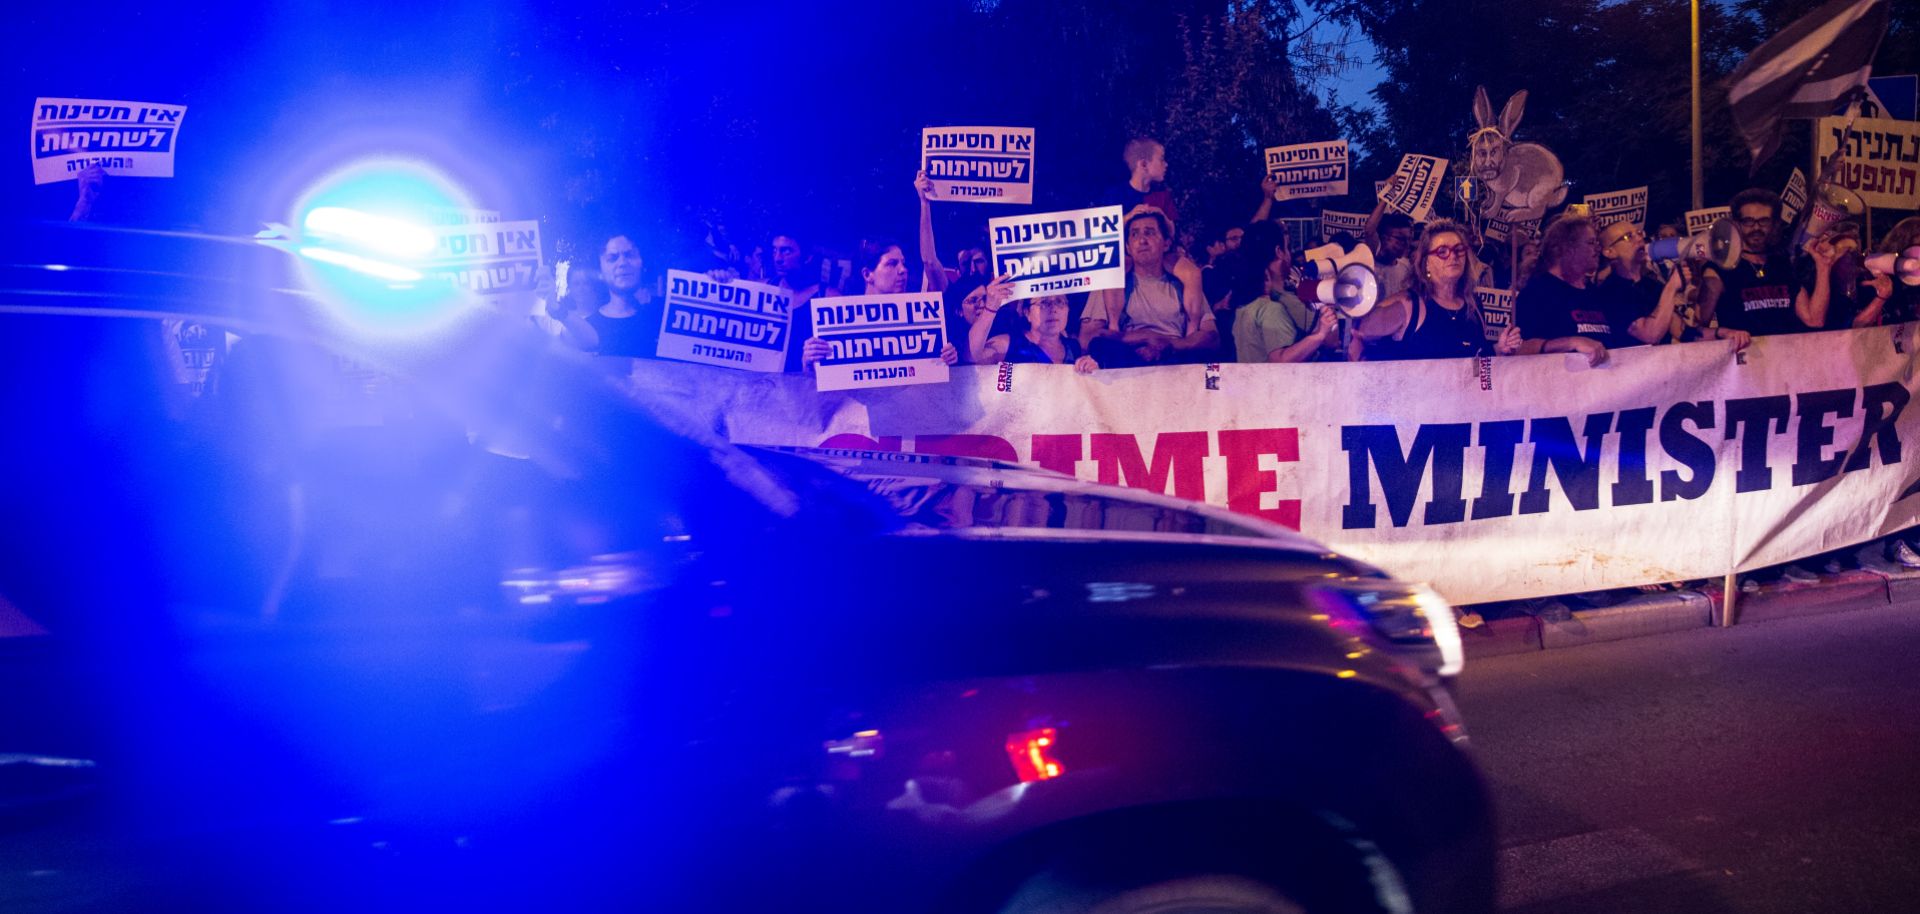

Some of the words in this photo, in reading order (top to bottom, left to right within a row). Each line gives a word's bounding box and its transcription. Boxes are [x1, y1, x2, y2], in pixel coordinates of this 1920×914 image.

[37, 104, 131, 121] חסינות
[137, 107, 181, 123] אין
[41, 128, 166, 152] לשחיתות
[925, 133, 995, 149] חסינות
[1001, 134, 1032, 153] אין
[1269, 148, 1320, 164] חסינות
[1323, 146, 1345, 160] אין
[930, 159, 1026, 179] לשחיתות
[1274, 164, 1343, 183] לשחיתות
[1401, 155, 1416, 173] אין
[950, 185, 997, 197] העבודה
[1400, 160, 1431, 212] לשחיתות
[1631, 191, 1646, 206] אין
[1083, 214, 1119, 240] אין
[1323, 213, 1356, 225] חסינות
[994, 219, 1077, 245] חסינות
[496, 229, 536, 256] אין
[1003, 244, 1115, 277] לשחיתות
[670, 277, 752, 307] חסינות
[1029, 277, 1083, 293] העבודה
[756, 291, 791, 315] אין
[905, 300, 940, 324] אין
[816, 302, 900, 326] חסינות
[671, 309, 782, 345] לשחיתות
[692, 343, 745, 362] העבודה
[825, 330, 937, 360] לשחיתות
[853, 366, 908, 381] העבודה
[997, 361, 1008, 392] CRIM
[1341, 381, 1911, 530] MINISTER
